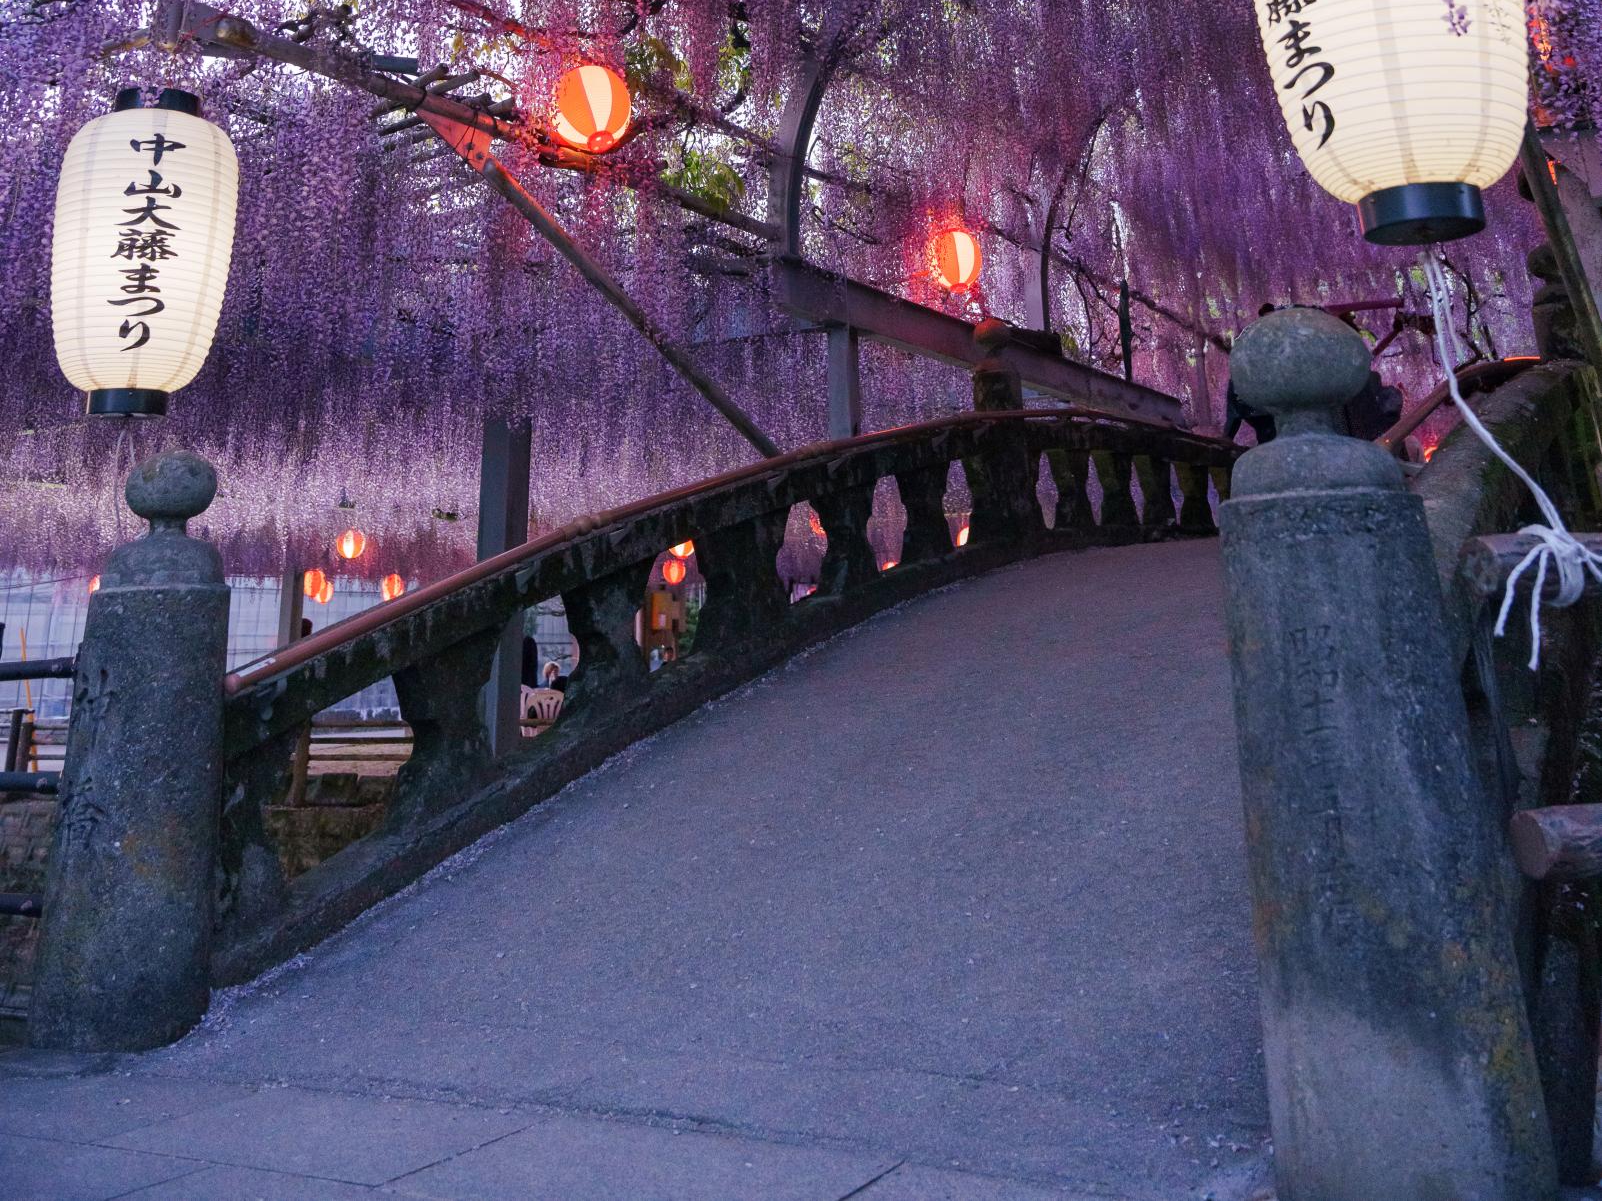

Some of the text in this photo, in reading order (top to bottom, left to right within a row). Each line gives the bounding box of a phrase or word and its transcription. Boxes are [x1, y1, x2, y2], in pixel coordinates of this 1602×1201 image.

[107, 133, 187, 352] 中山大藤まつり
